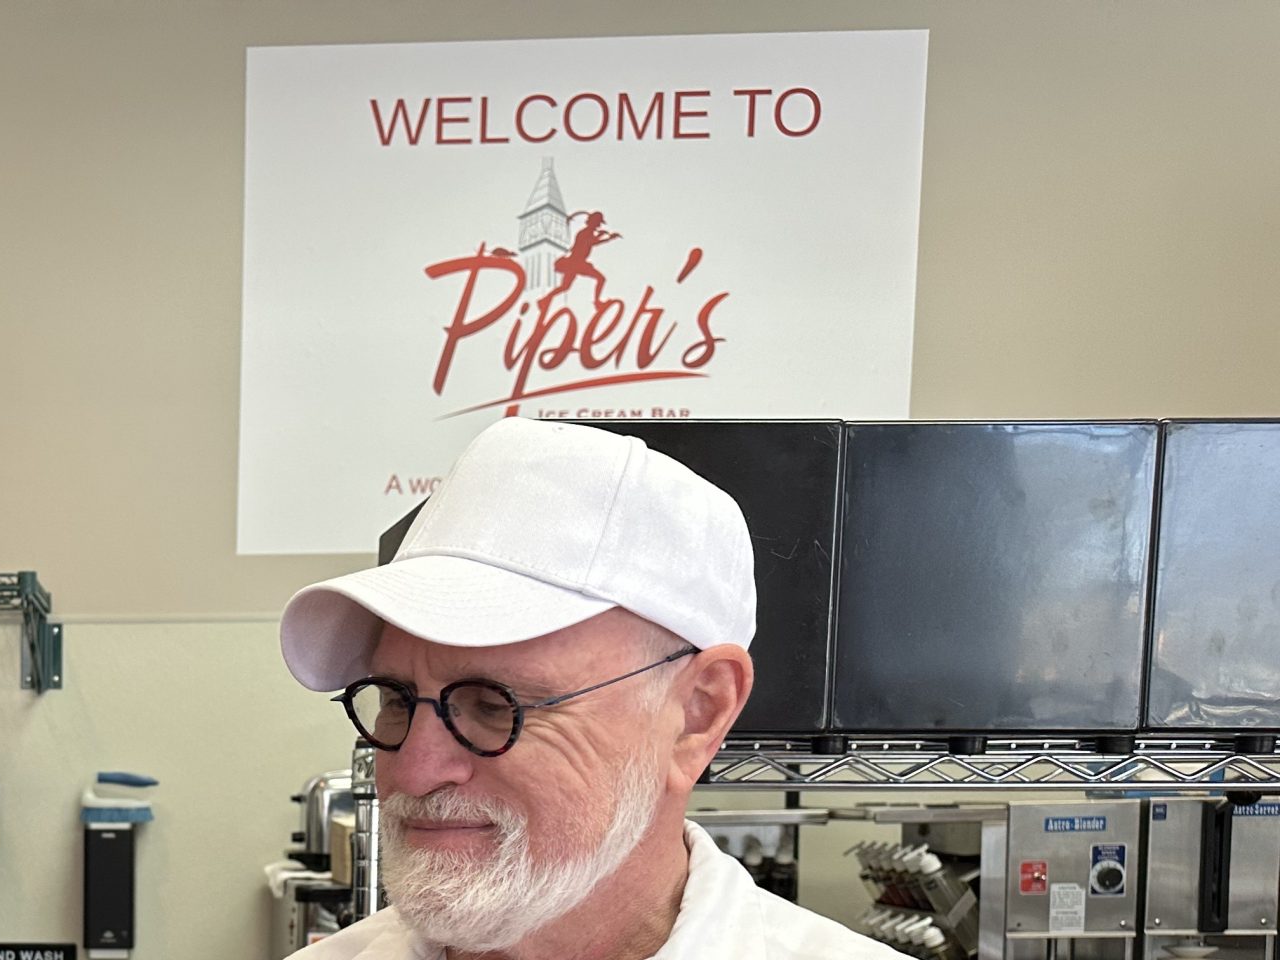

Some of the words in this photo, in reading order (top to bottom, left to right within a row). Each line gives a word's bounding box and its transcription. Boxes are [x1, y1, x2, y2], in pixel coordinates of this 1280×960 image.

[370, 90, 712, 147] WELCOME
[732, 87, 823, 138] TO
[423, 243, 731, 417] Piper's
[384, 475, 403, 495] A
